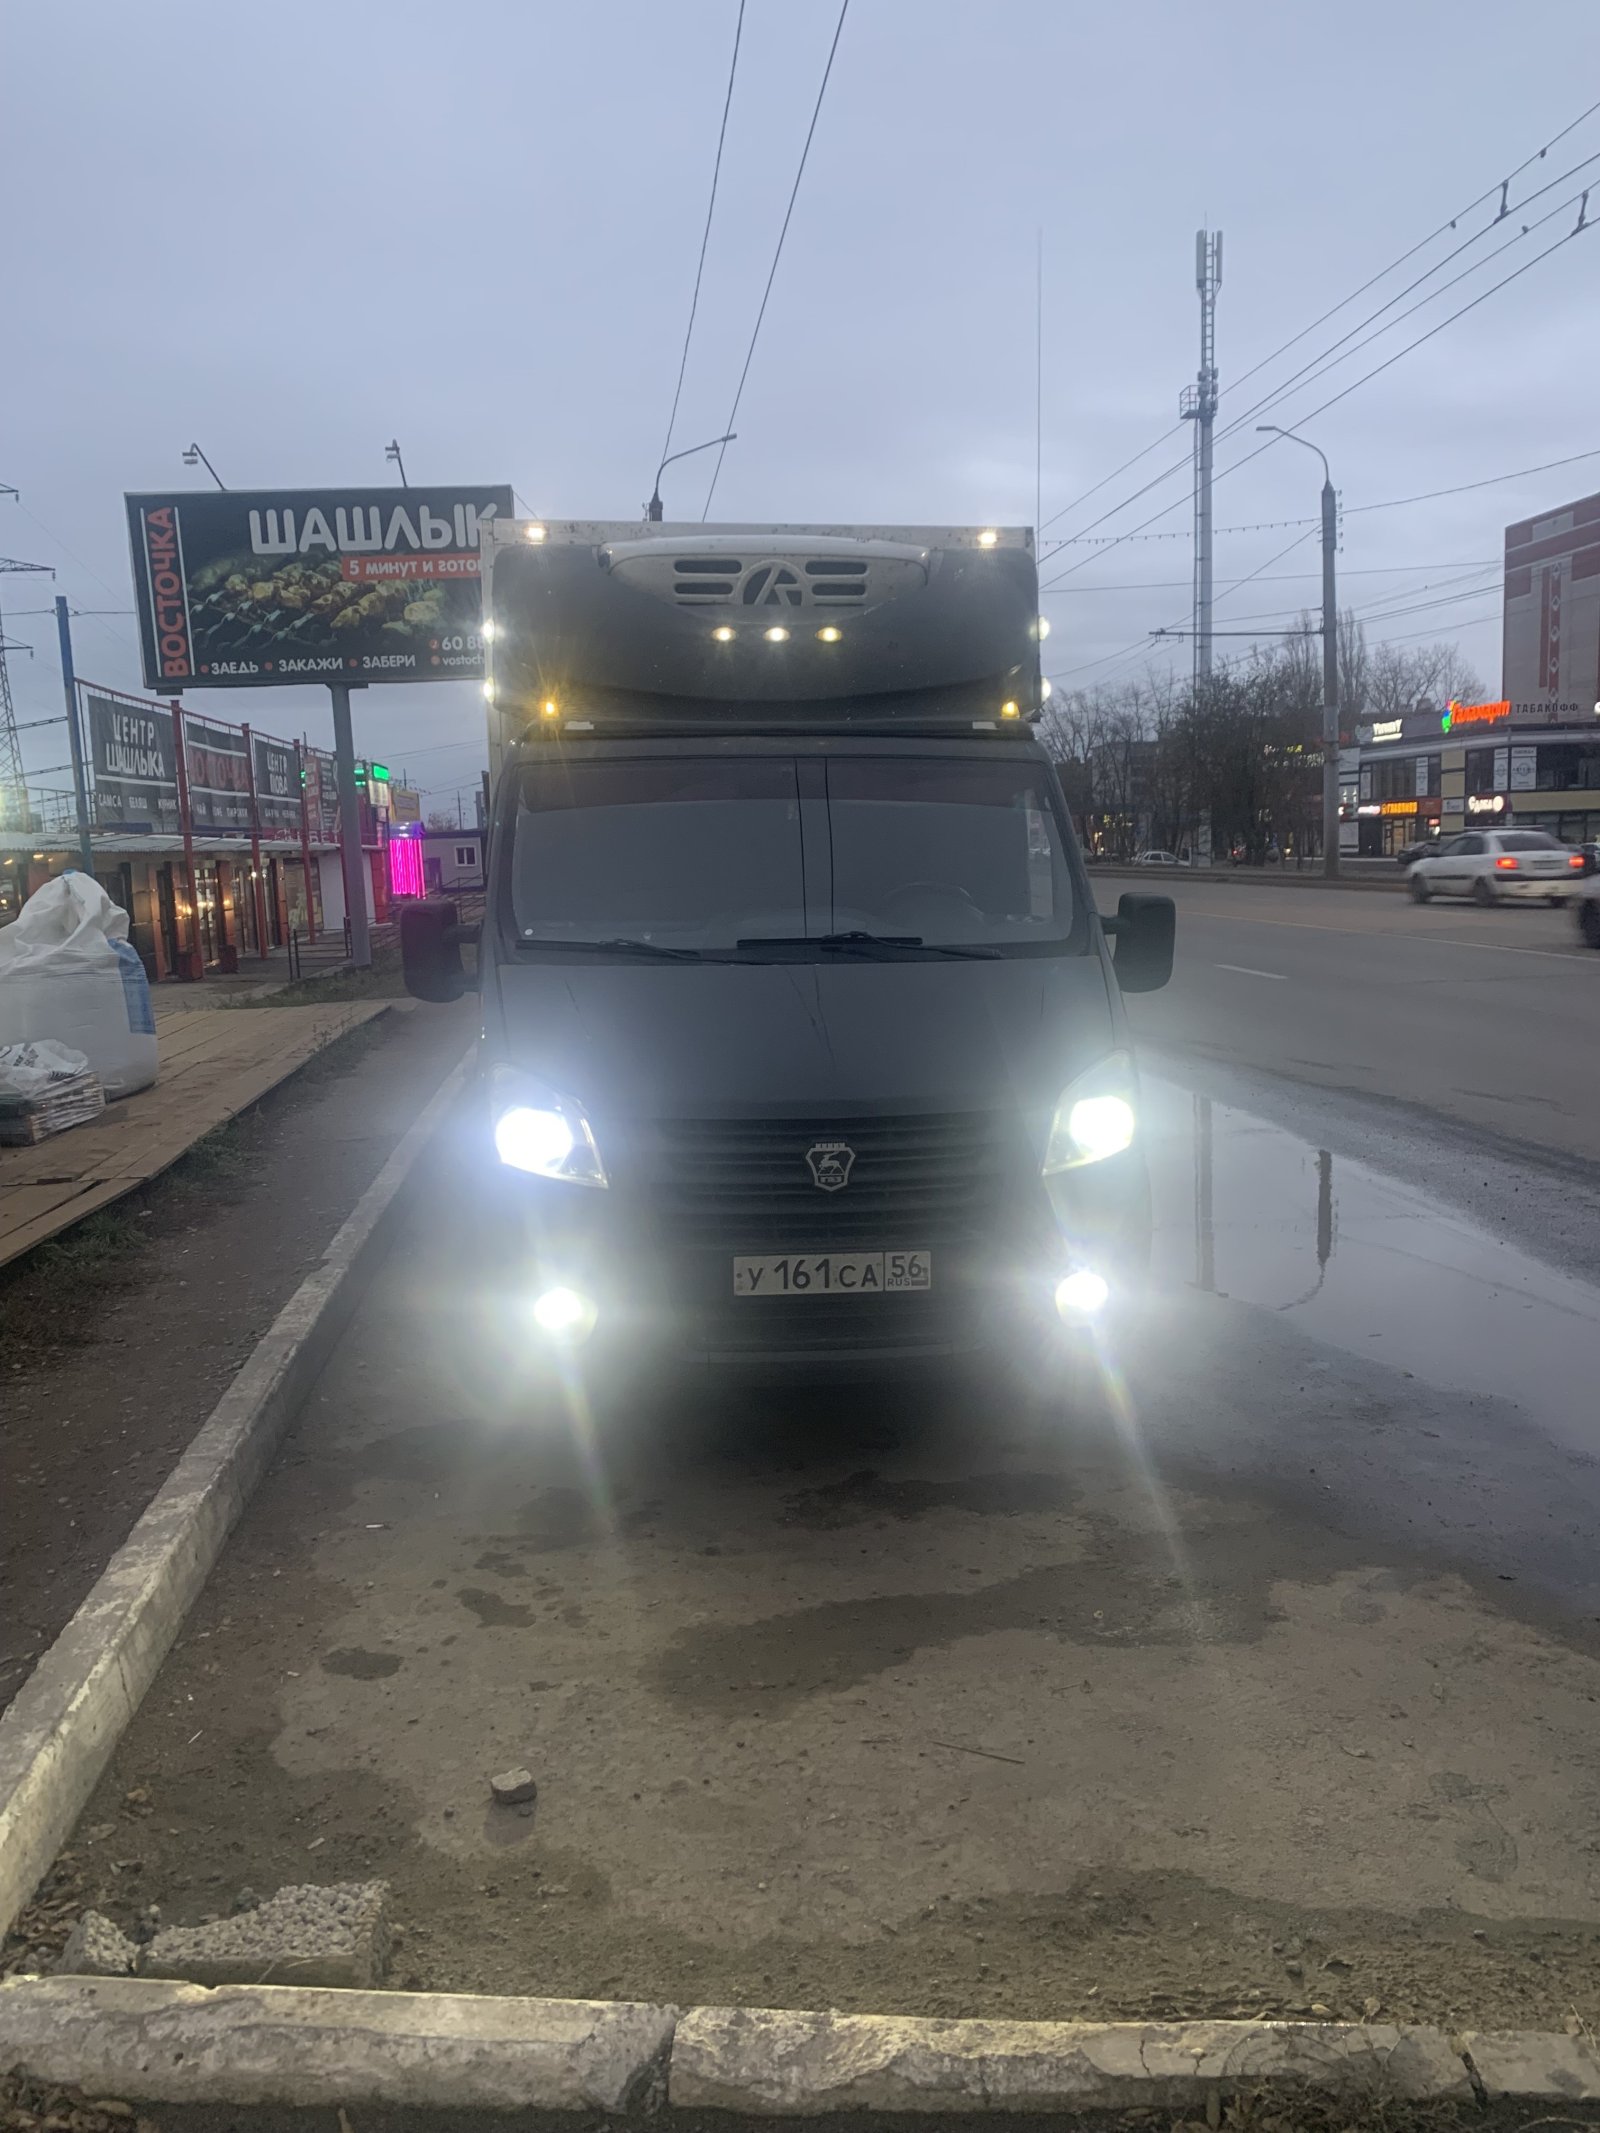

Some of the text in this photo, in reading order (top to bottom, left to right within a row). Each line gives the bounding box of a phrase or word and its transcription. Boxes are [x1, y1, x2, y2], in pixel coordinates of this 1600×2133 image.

[249, 502, 498, 554] ШАШЛЫК
[349, 559, 481, 577] 5 минут и гото
[147, 506, 189, 677] ВОСТОЧКА
[441, 635, 464, 651] 60
[211, 653, 416, 676] ЗАЕДЬ ЗАКАЖИ ЗАБЕРИ
[442, 653, 485, 666] vostoch
[1516, 702, 1579, 713] ТАБАКОФФ
[112, 713, 155, 747] ЦЕНТР
[106, 742, 166, 778] ШАШЛЫКА
[266, 751, 288, 774] ЦЕНТР
[98, 793, 123, 808] САМСА
[891, 1254, 923, 1278] 56
[887, 1277, 910, 1287] RUS
